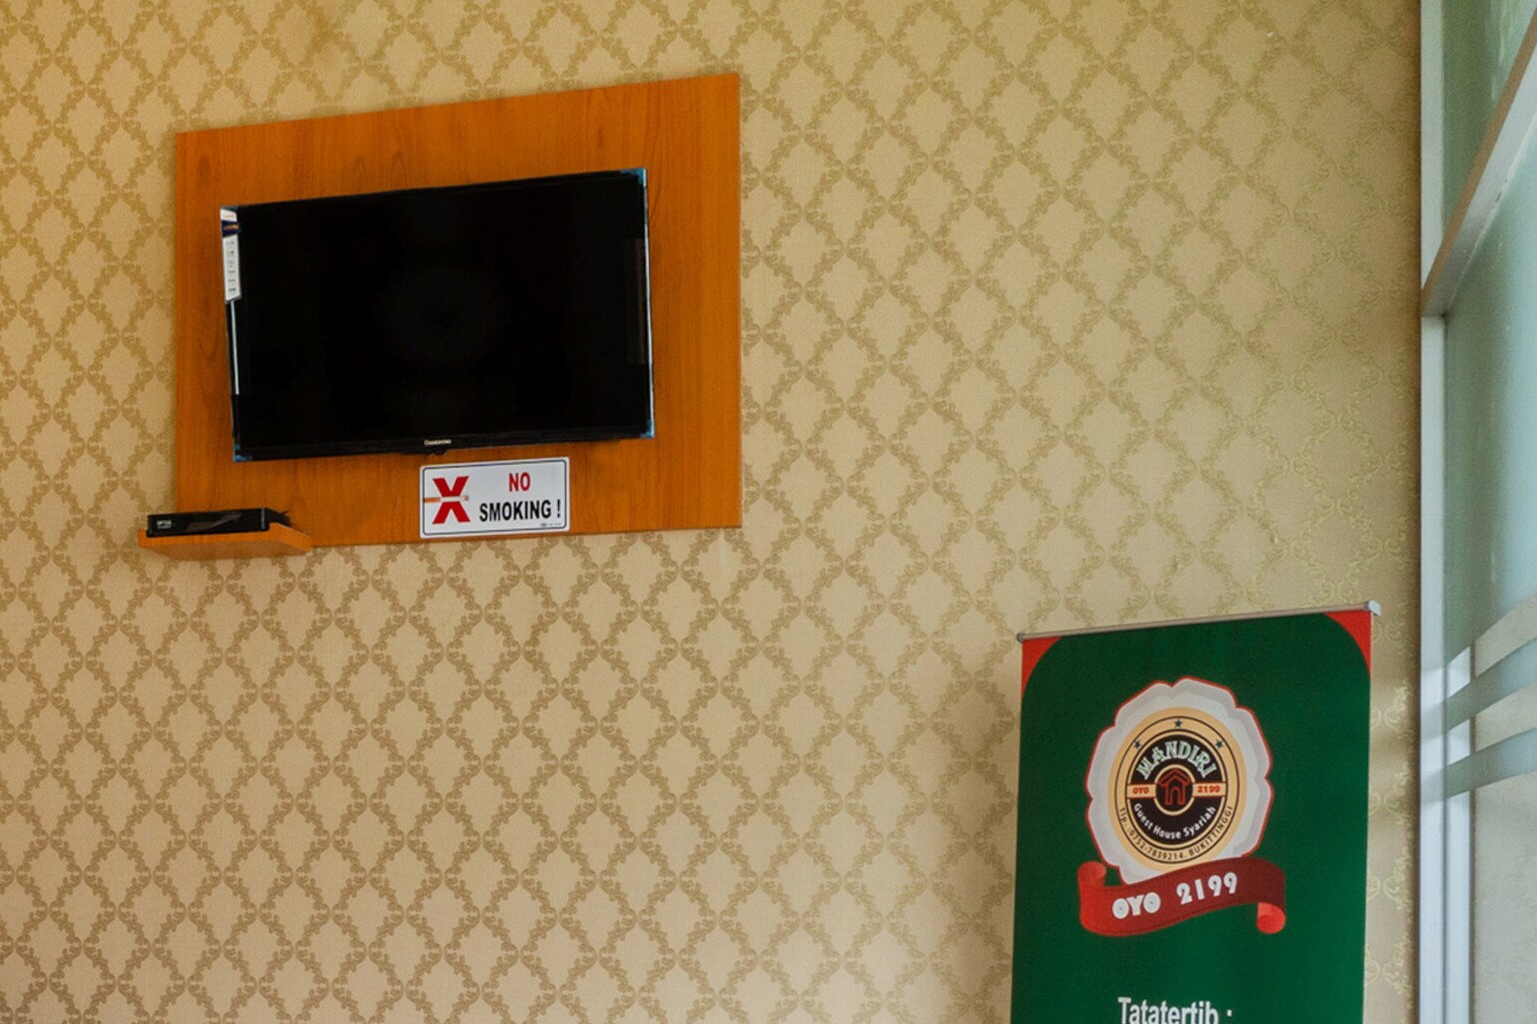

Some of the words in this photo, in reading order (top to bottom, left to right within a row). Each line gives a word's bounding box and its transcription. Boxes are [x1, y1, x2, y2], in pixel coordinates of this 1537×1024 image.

[508, 472, 531, 492] NO
[479, 500, 552, 522] SMOKING
[1136, 740, 1217, 780] MANDIRI
[1197, 785, 1220, 794] 2199
[1133, 803, 1153, 830] Guest
[1153, 825, 1181, 840] House
[1183, 806, 1217, 837] Syariah
[1112, 892, 1161, 919] OYO
[1176, 872, 1237, 905] 2199
